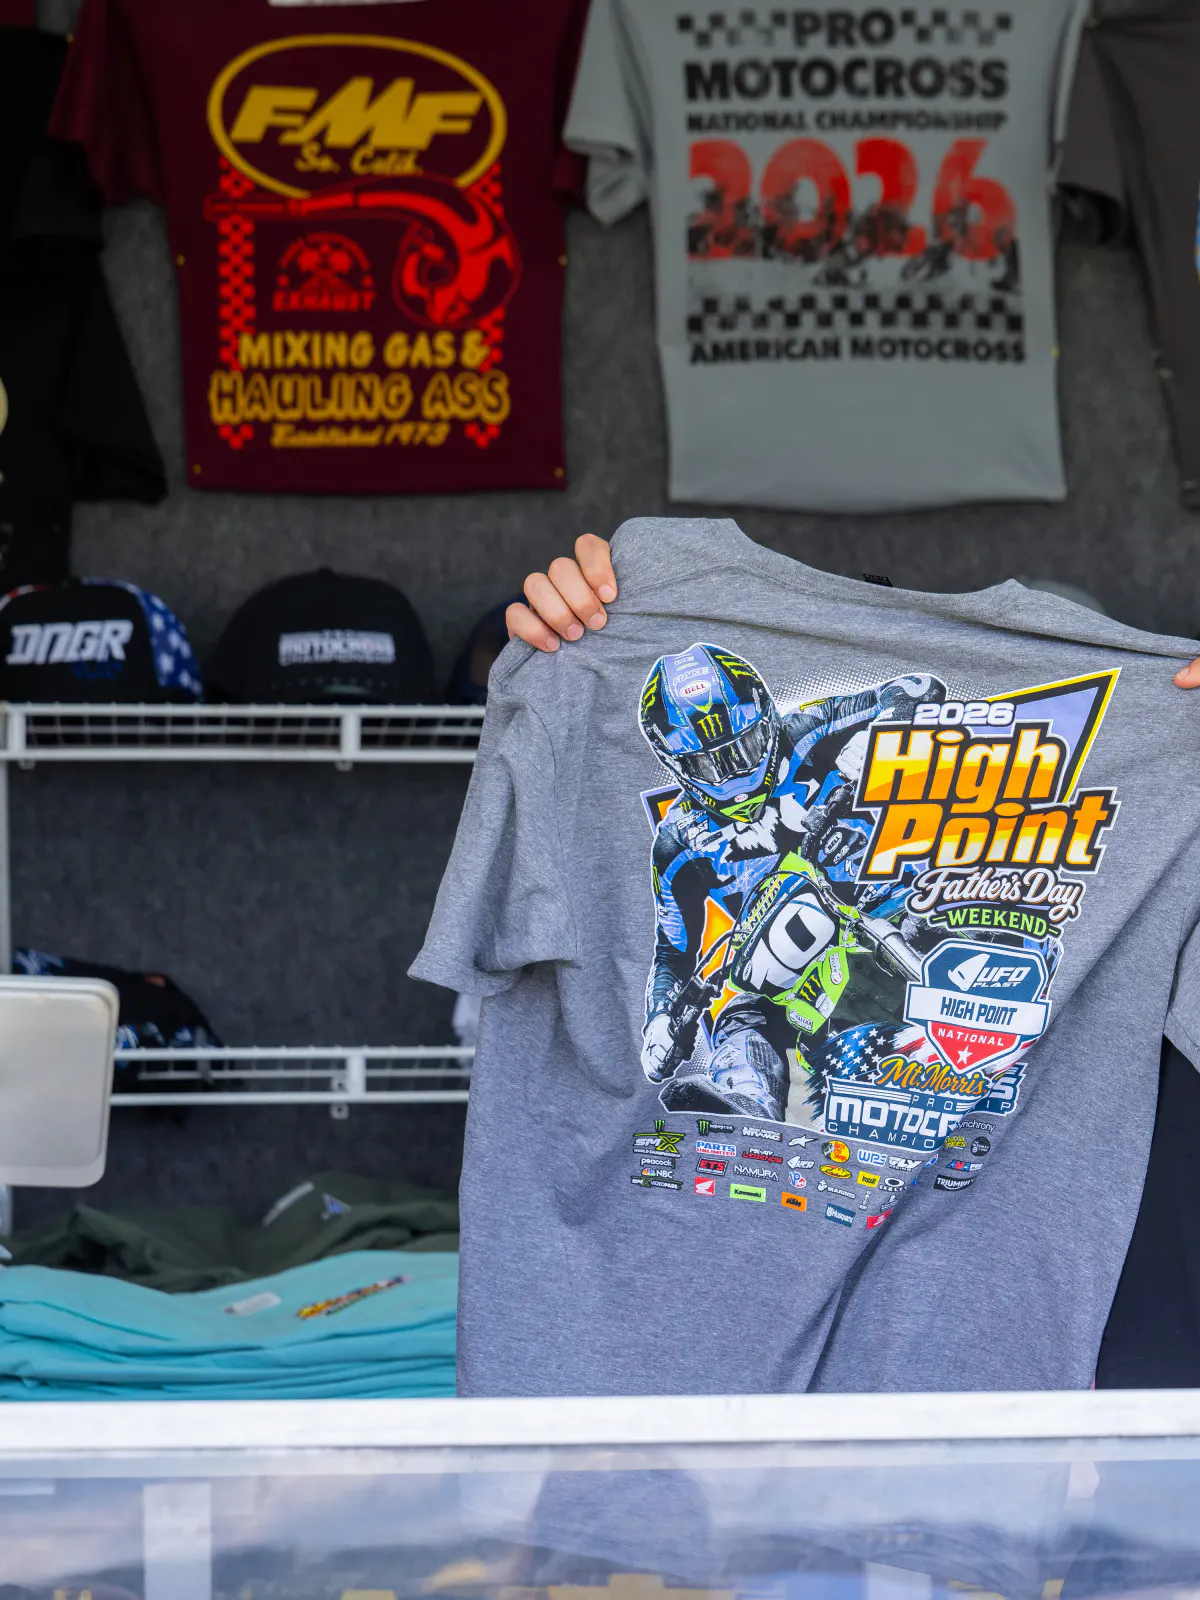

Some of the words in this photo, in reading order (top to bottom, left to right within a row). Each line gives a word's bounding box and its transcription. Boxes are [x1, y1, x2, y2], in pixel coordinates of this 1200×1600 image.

[793, 10, 896, 48] PRO
[683, 55, 1009, 101] MOTOCROSS
[230, 76, 482, 149] FMF
[687, 110, 807, 133] NATIONAL
[814, 109, 1009, 132] CHAMPIONSHIP
[687, 137, 1017, 263] 2026
[239, 330, 375, 368] MIXING
[383, 331, 456, 368] GAS
[460, 330, 490, 368] &
[690, 337, 843, 364] AMERICAN
[851, 338, 1026, 363] MOTOCROSS
[209, 370, 413, 425] HAULING
[421, 369, 511, 424] ASS
[912, 702, 1016, 726] 2026
[863, 728, 1061, 814] High
[867, 795, 1109, 875] Point
[911, 865, 1022, 911] Father's
[1023, 867, 1080, 923] Day
[947, 907, 1047, 937] WEEKEND
[976, 966, 1031, 982] UFO
[940, 996, 974, 1020] HIGH
[976, 1004, 1018, 1026] POINT
[937, 1027, 1004, 1047] NATIONAL
[911, 1096, 953, 1112] PRO
[696, 1141, 735, 1152] PARTS
[858, 1151, 887, 1166] WPS
[641, 1158, 673, 1166] peacock
[656, 1170, 674, 1179] NBC
[700, 1159, 726, 1171] ETS
[734, 1165, 779, 1181] NAMURA
[828, 1186, 856, 1199] MARINES
